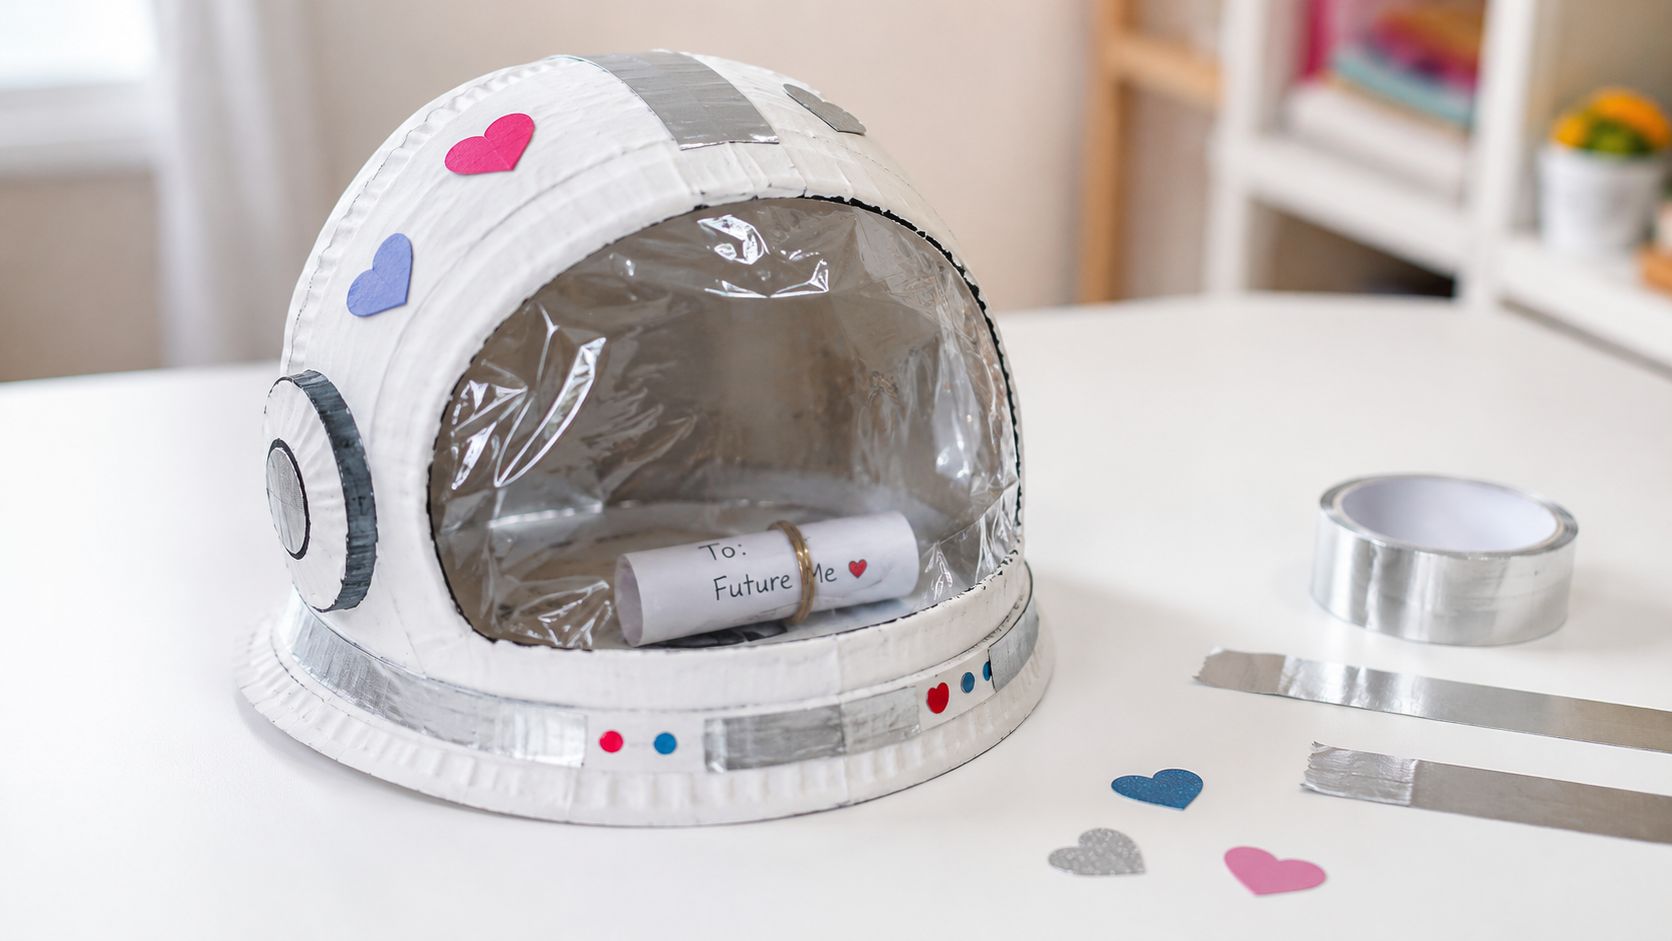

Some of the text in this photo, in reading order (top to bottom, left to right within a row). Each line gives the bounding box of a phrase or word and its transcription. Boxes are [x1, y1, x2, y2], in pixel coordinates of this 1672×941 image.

[698, 542, 747, 561] To:
[713, 562, 838, 601] Future Me
